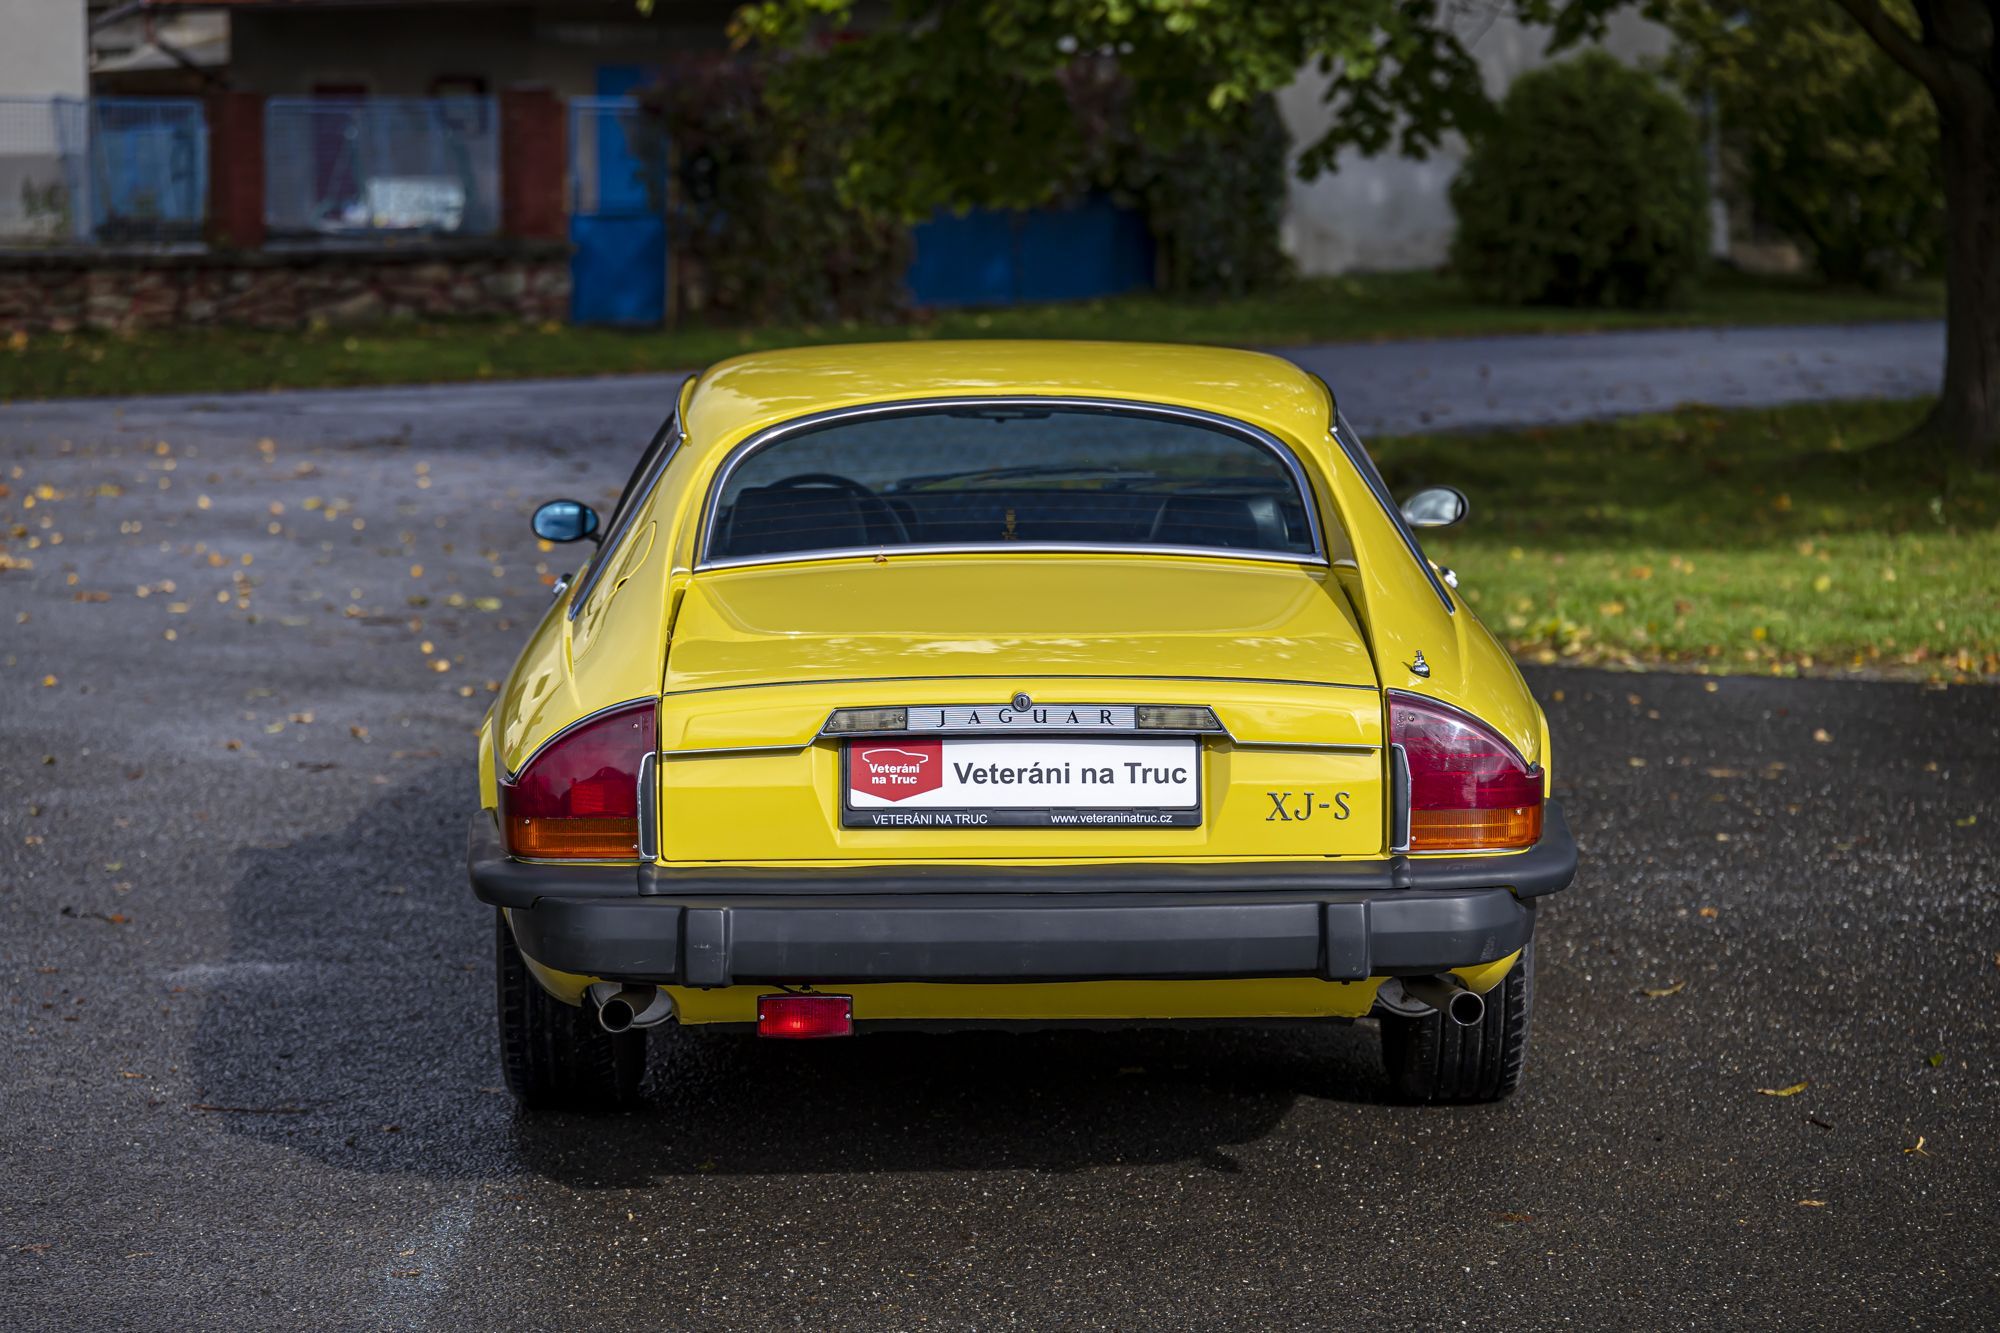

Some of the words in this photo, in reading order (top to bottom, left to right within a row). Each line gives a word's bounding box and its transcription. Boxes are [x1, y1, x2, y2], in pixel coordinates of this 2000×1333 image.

[936, 709, 1114, 728] JAGUAR
[869, 763, 920, 774] Veteráni
[953, 762, 1070, 785] Veteráni
[1081, 767, 1115, 785] na
[1124, 762, 1188, 785] Truc
[871, 777, 887, 785] na
[890, 775, 918, 785] Truc
[1266, 792, 1350, 821] XJ-S
[872, 812, 933, 825] VETERÁNI
[935, 814, 952, 825] NA
[954, 814, 988, 825] TRUC
[1051, 813, 1173, 824] www.veteraninatruc.cz
